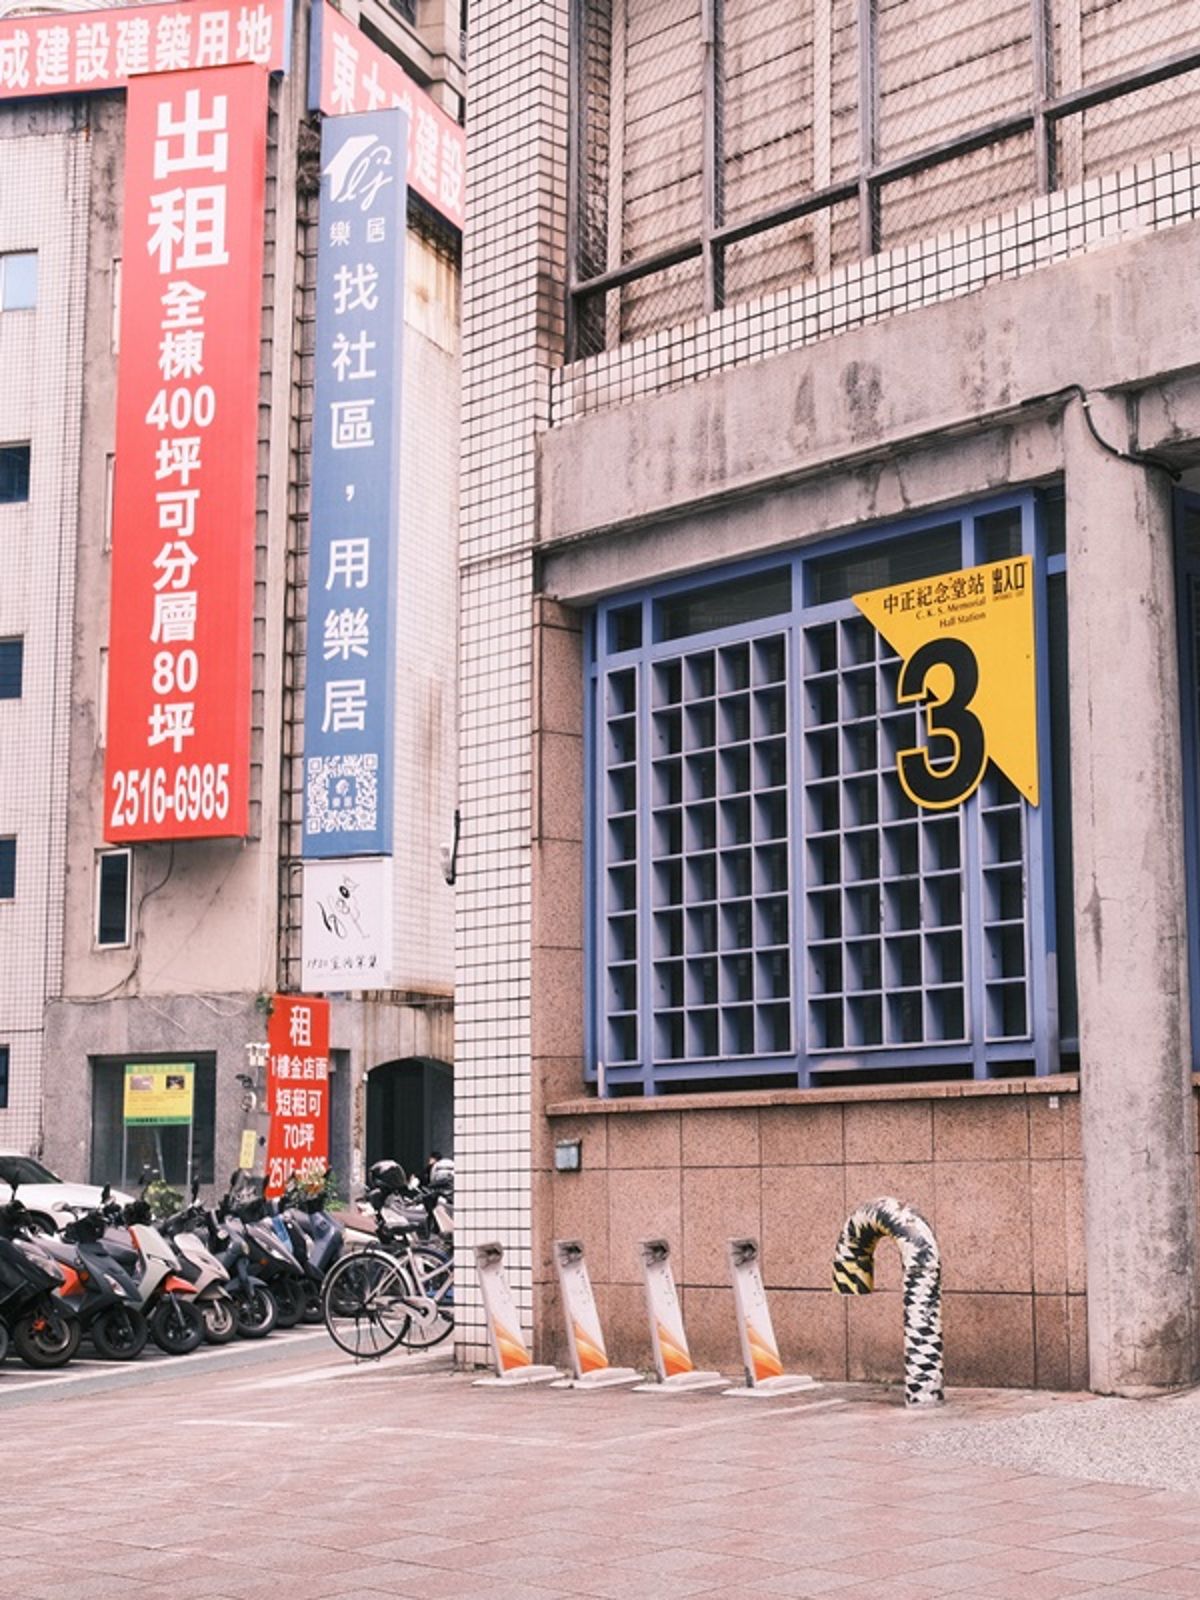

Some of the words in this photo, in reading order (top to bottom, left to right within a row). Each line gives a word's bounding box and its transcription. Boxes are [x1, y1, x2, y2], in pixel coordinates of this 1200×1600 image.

[331, 31, 463, 217] 東大建設
[147, 89, 229, 275] 出租
[330, 217, 386, 247] 樂居
[883, 574, 985, 615] 中正紀念堂站
[948, 596, 986, 613] Memorial
[939, 615, 956, 629] Hall
[958, 611, 986, 624] Station
[897, 637, 989, 809] 3
[111, 763, 229, 828] 2516-6985
[289, 1005, 312, 1047] 租
[275, 1088, 322, 1118] 短租可
[283, 1123, 315, 1151] 70坪
